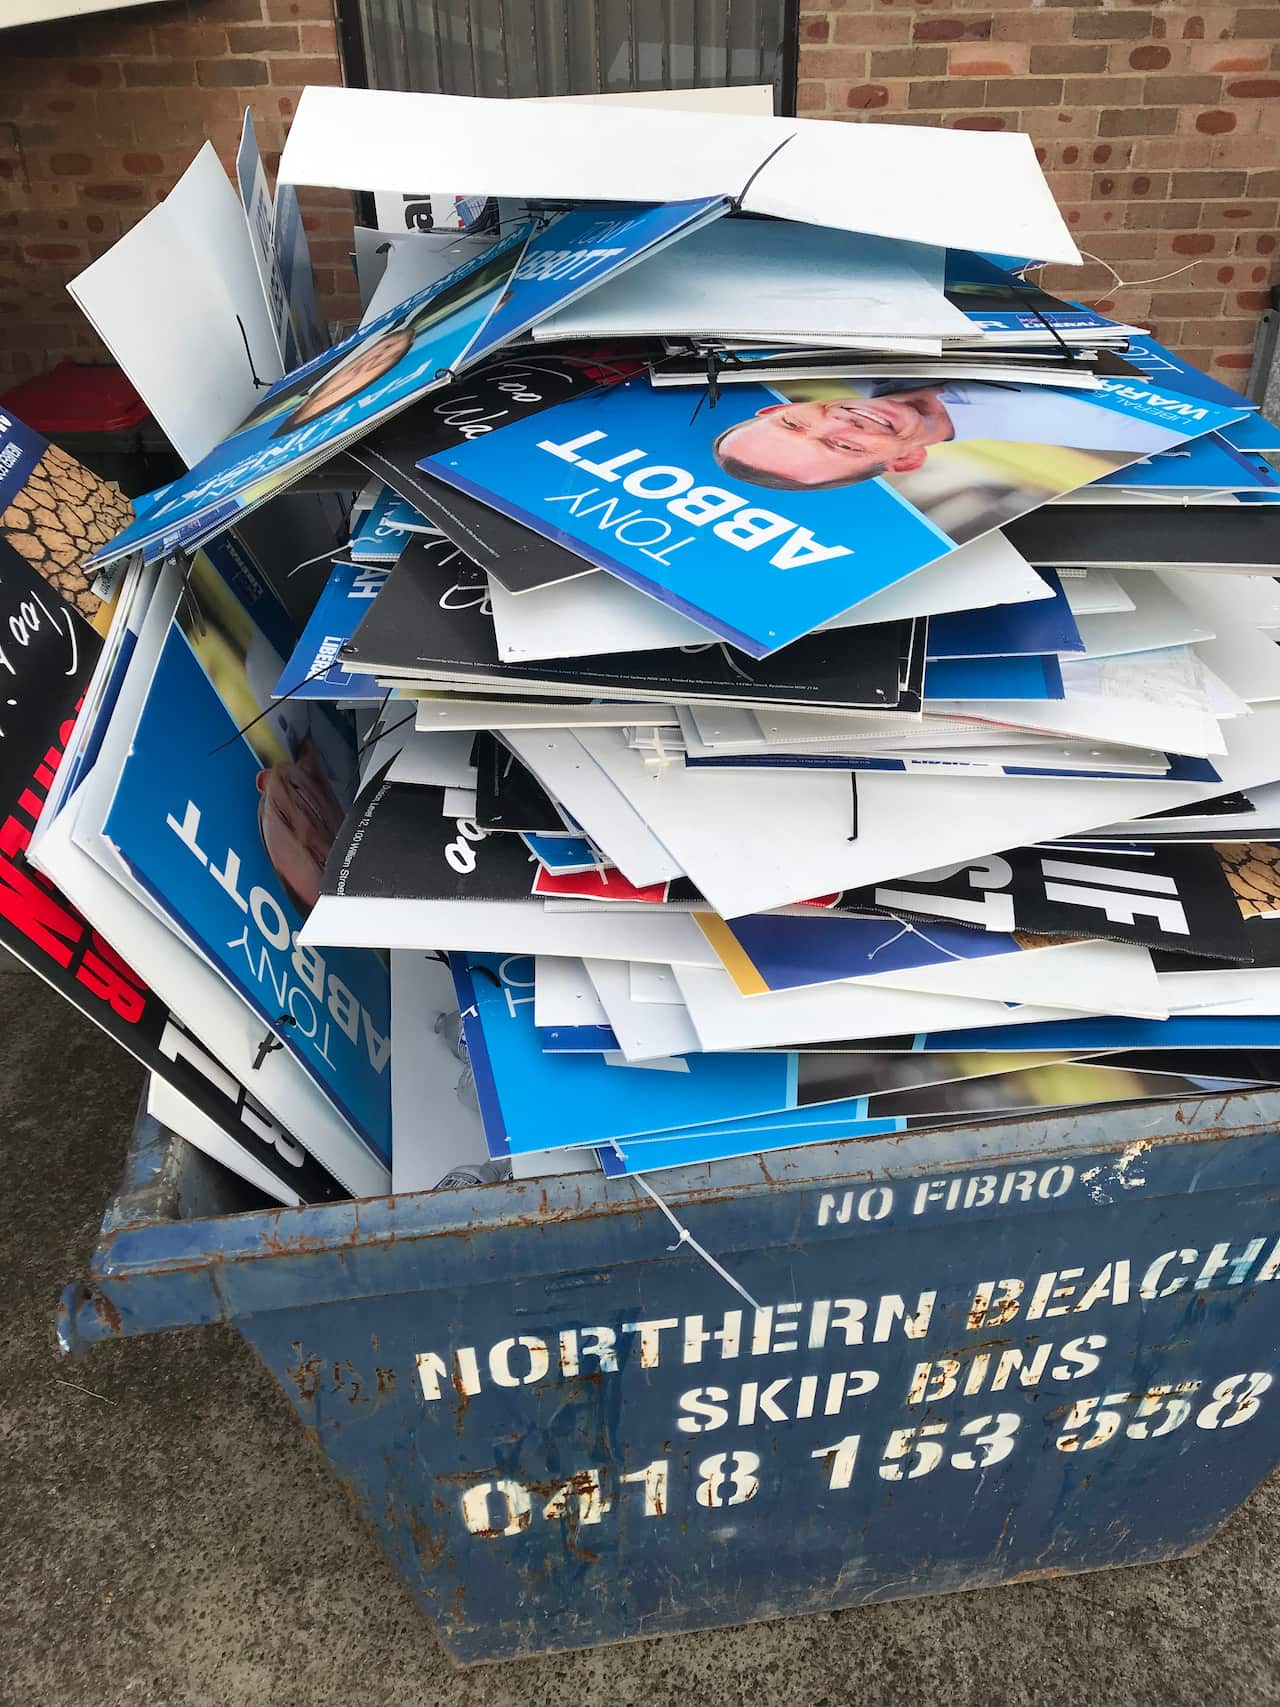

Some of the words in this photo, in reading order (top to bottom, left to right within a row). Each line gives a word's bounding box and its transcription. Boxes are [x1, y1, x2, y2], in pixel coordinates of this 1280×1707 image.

[1113, 397, 1192, 425] LIBERAL
[536, 430, 855, 570] ABBOTT
[544, 487, 696, 566] TONY
[352, 829, 365, 842] 100
[364, 802, 380, 818] Level
[342, 842, 360, 868] William
[1040, 858, 1191, 935] IF
[166, 800, 391, 1074] ABBOTT
[226, 926, 336, 1072] TONY
[817, 1187, 893, 1227] NO
[913, 1165, 1075, 1215] FIBRO
[415, 1290, 937, 1400] NORTHERN
[677, 1370, 879, 1433] SKIP
[907, 1335, 1107, 1404] BINS
[461, 1451, 761, 1537] 0418
[813, 1414, 1020, 1490] 153
[1056, 1372, 1273, 1452] 558
